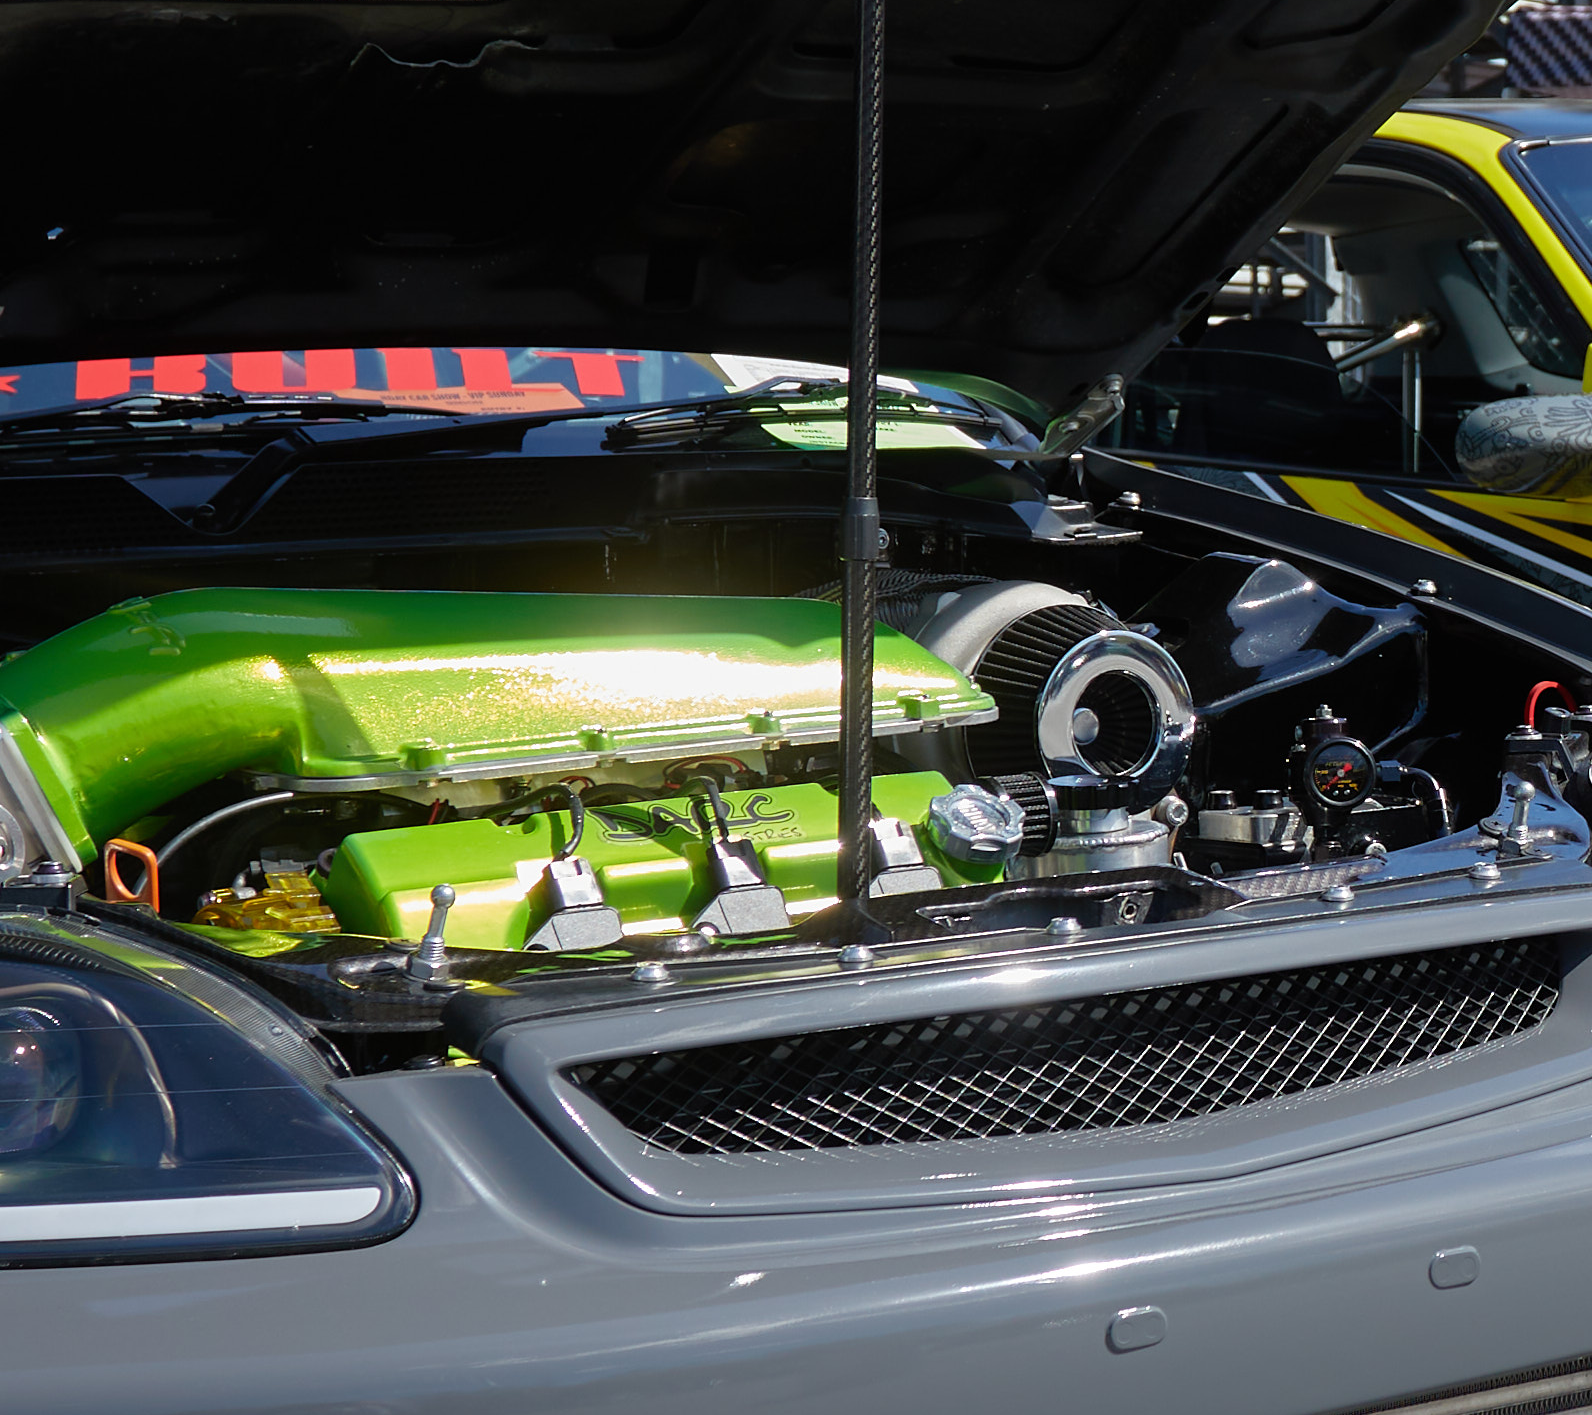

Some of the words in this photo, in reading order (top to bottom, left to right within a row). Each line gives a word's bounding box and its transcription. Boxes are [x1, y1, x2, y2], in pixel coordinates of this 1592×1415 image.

[76, 347, 645, 401] BUILT
[468, 391, 484, 399] VIP
[486, 391, 526, 399] SUNDAY
